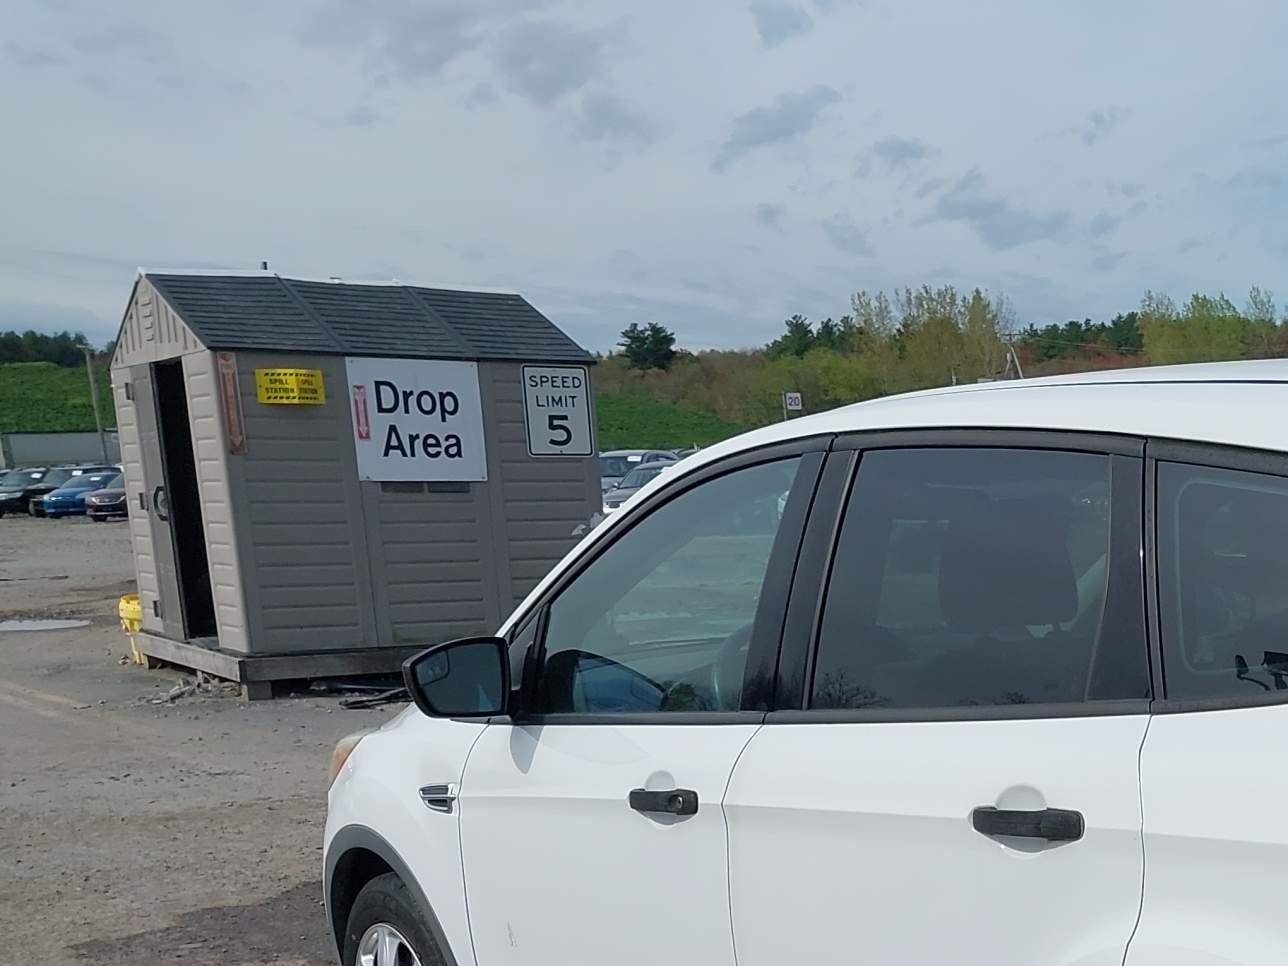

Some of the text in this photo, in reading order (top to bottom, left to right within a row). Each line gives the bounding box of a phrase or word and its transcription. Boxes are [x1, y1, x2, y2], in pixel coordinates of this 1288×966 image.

[528, 375, 582, 389] SPEED
[264, 387, 296, 395] STATION
[373, 380, 459, 423] Drop
[535, 394, 577, 408] LIMIT
[787, 396, 800, 407] 20
[547, 414, 573, 447] 5
[383, 424, 463, 458] Area
